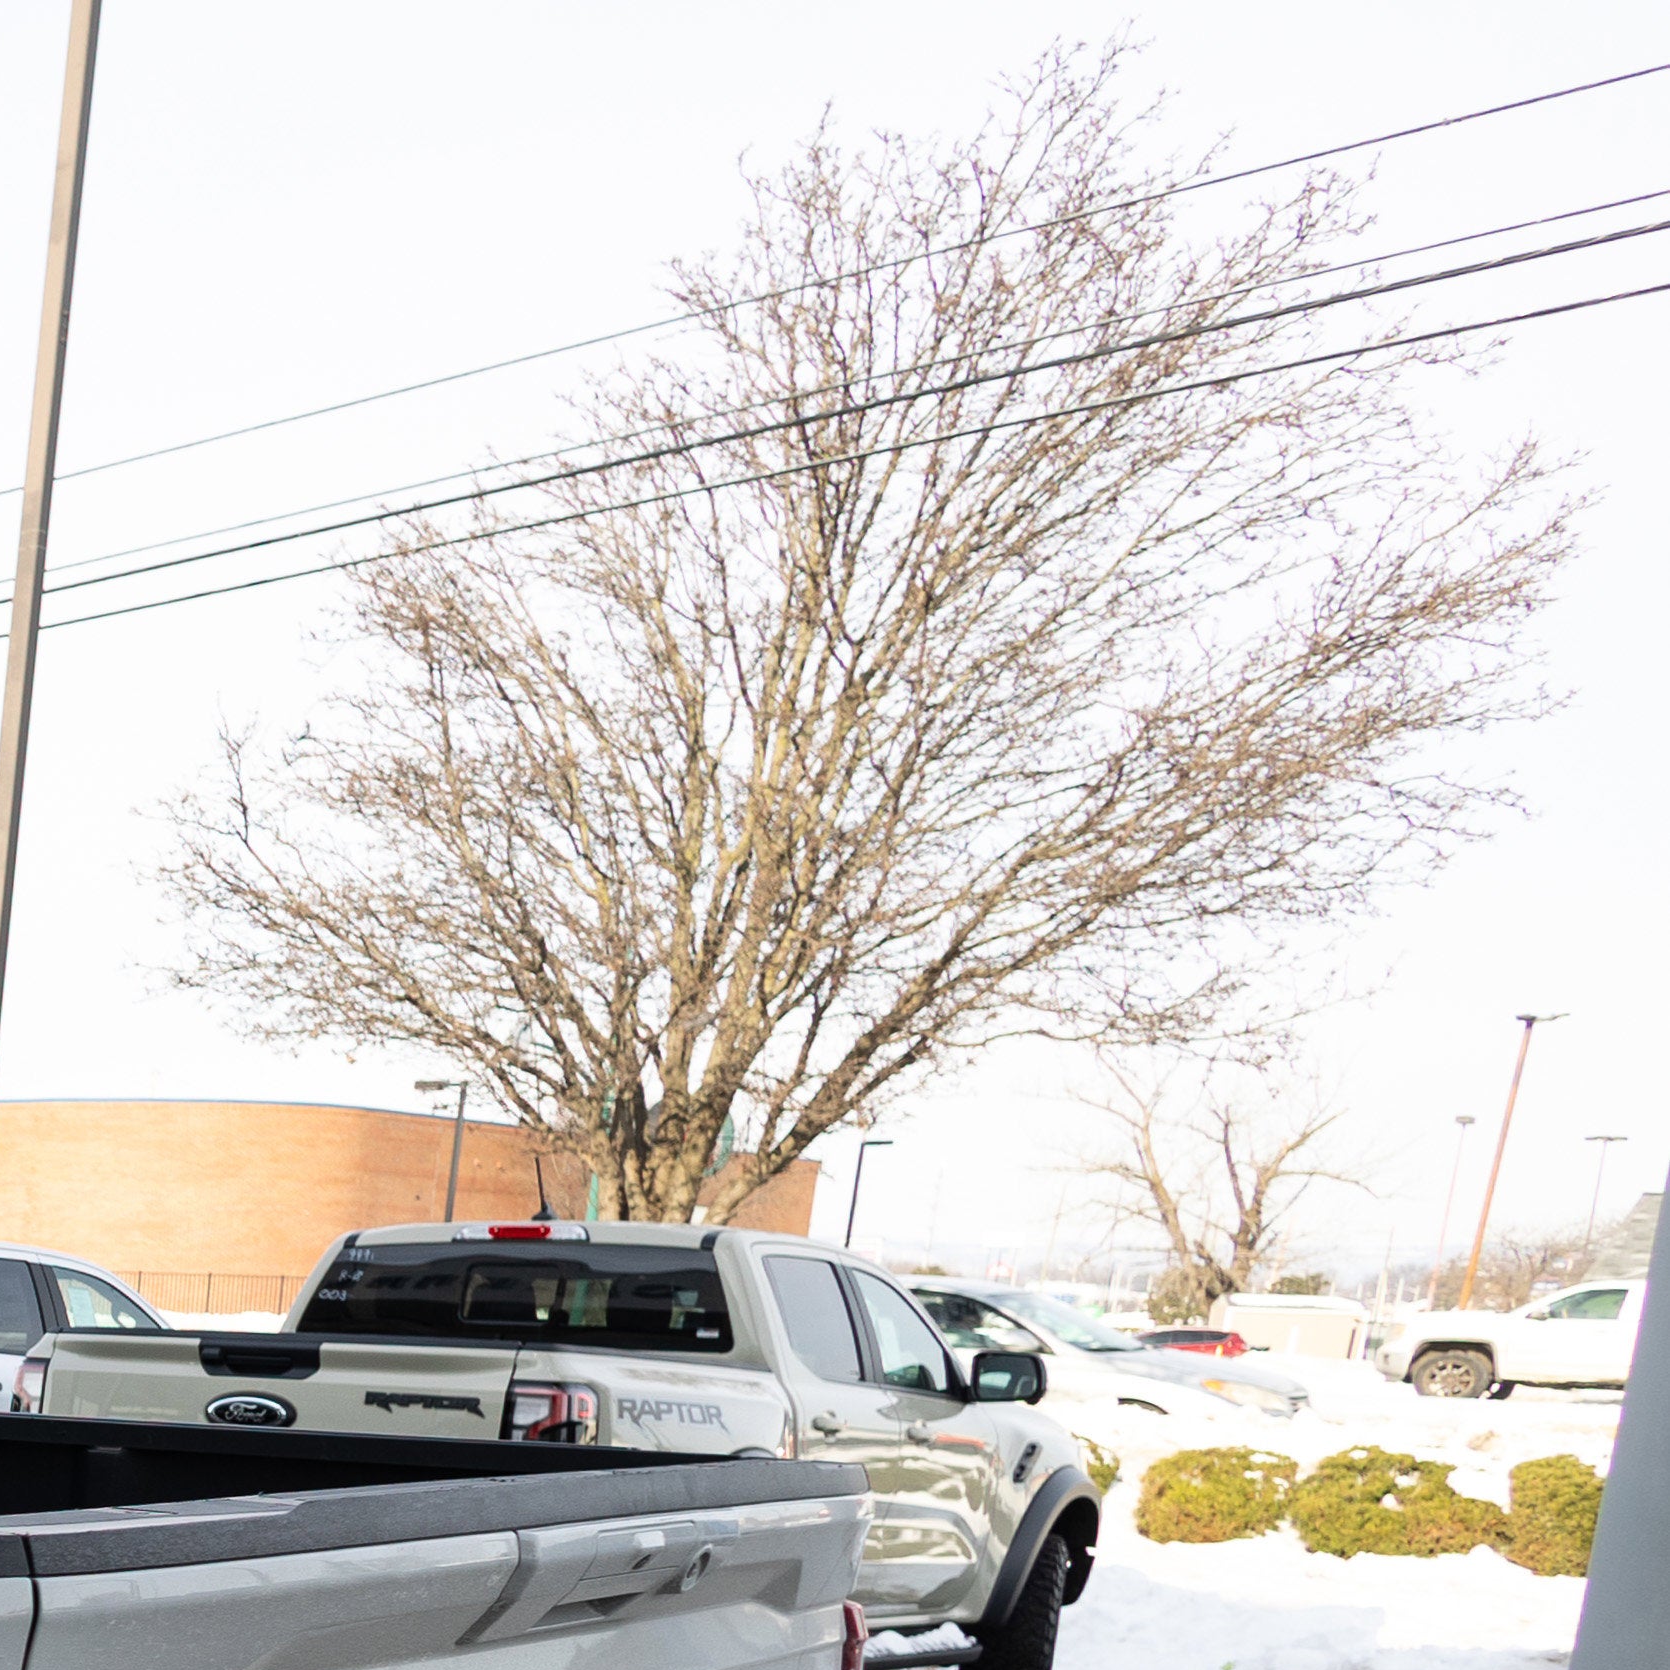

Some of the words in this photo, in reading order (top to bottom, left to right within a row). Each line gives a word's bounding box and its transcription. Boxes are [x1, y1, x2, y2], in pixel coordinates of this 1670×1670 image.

[224, 1401, 267, 1423] Ford
[364, 1391, 486, 1419] RAPTOR
[617, 1398, 731, 1436] RAPTOR
